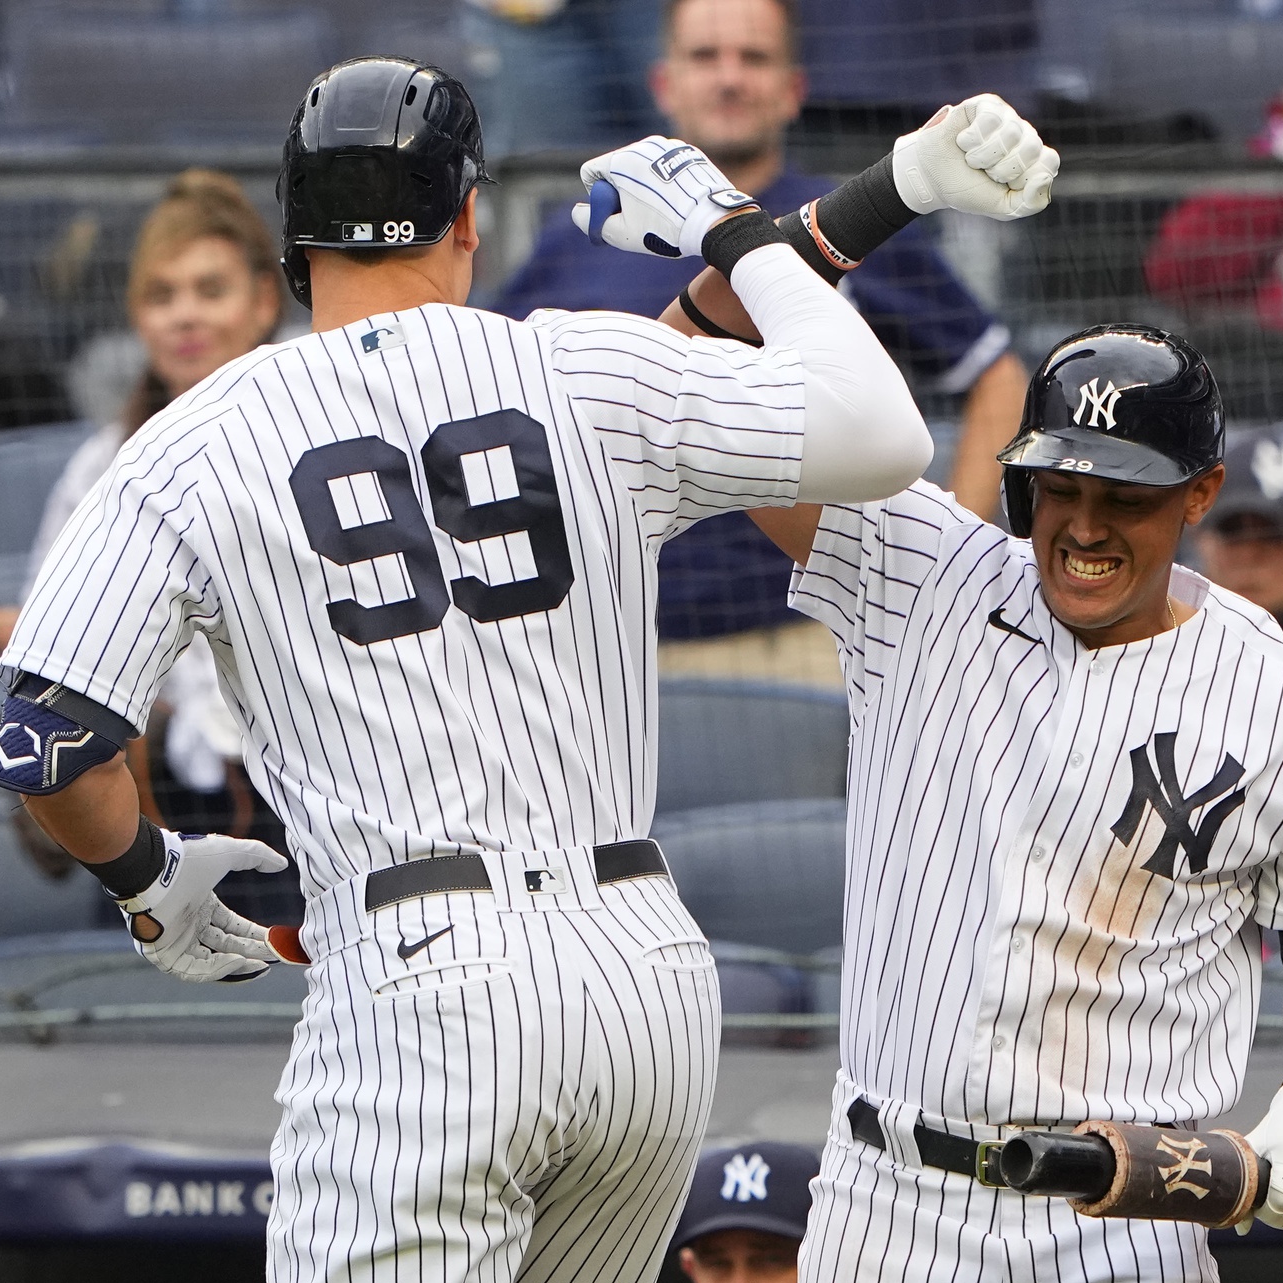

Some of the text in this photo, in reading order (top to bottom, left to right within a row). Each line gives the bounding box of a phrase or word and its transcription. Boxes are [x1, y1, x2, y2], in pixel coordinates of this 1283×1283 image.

[383, 221, 415, 243] 99
[1073, 377, 1122, 430] NY
[1058, 458, 1093, 472] 29
[288, 408, 575, 646] 99
[1110, 732, 1246, 880] NY
[720, 1153, 771, 1202] NY
[1156, 1134, 1212, 1200] NY
[125, 1180, 246, 1218] BANK
